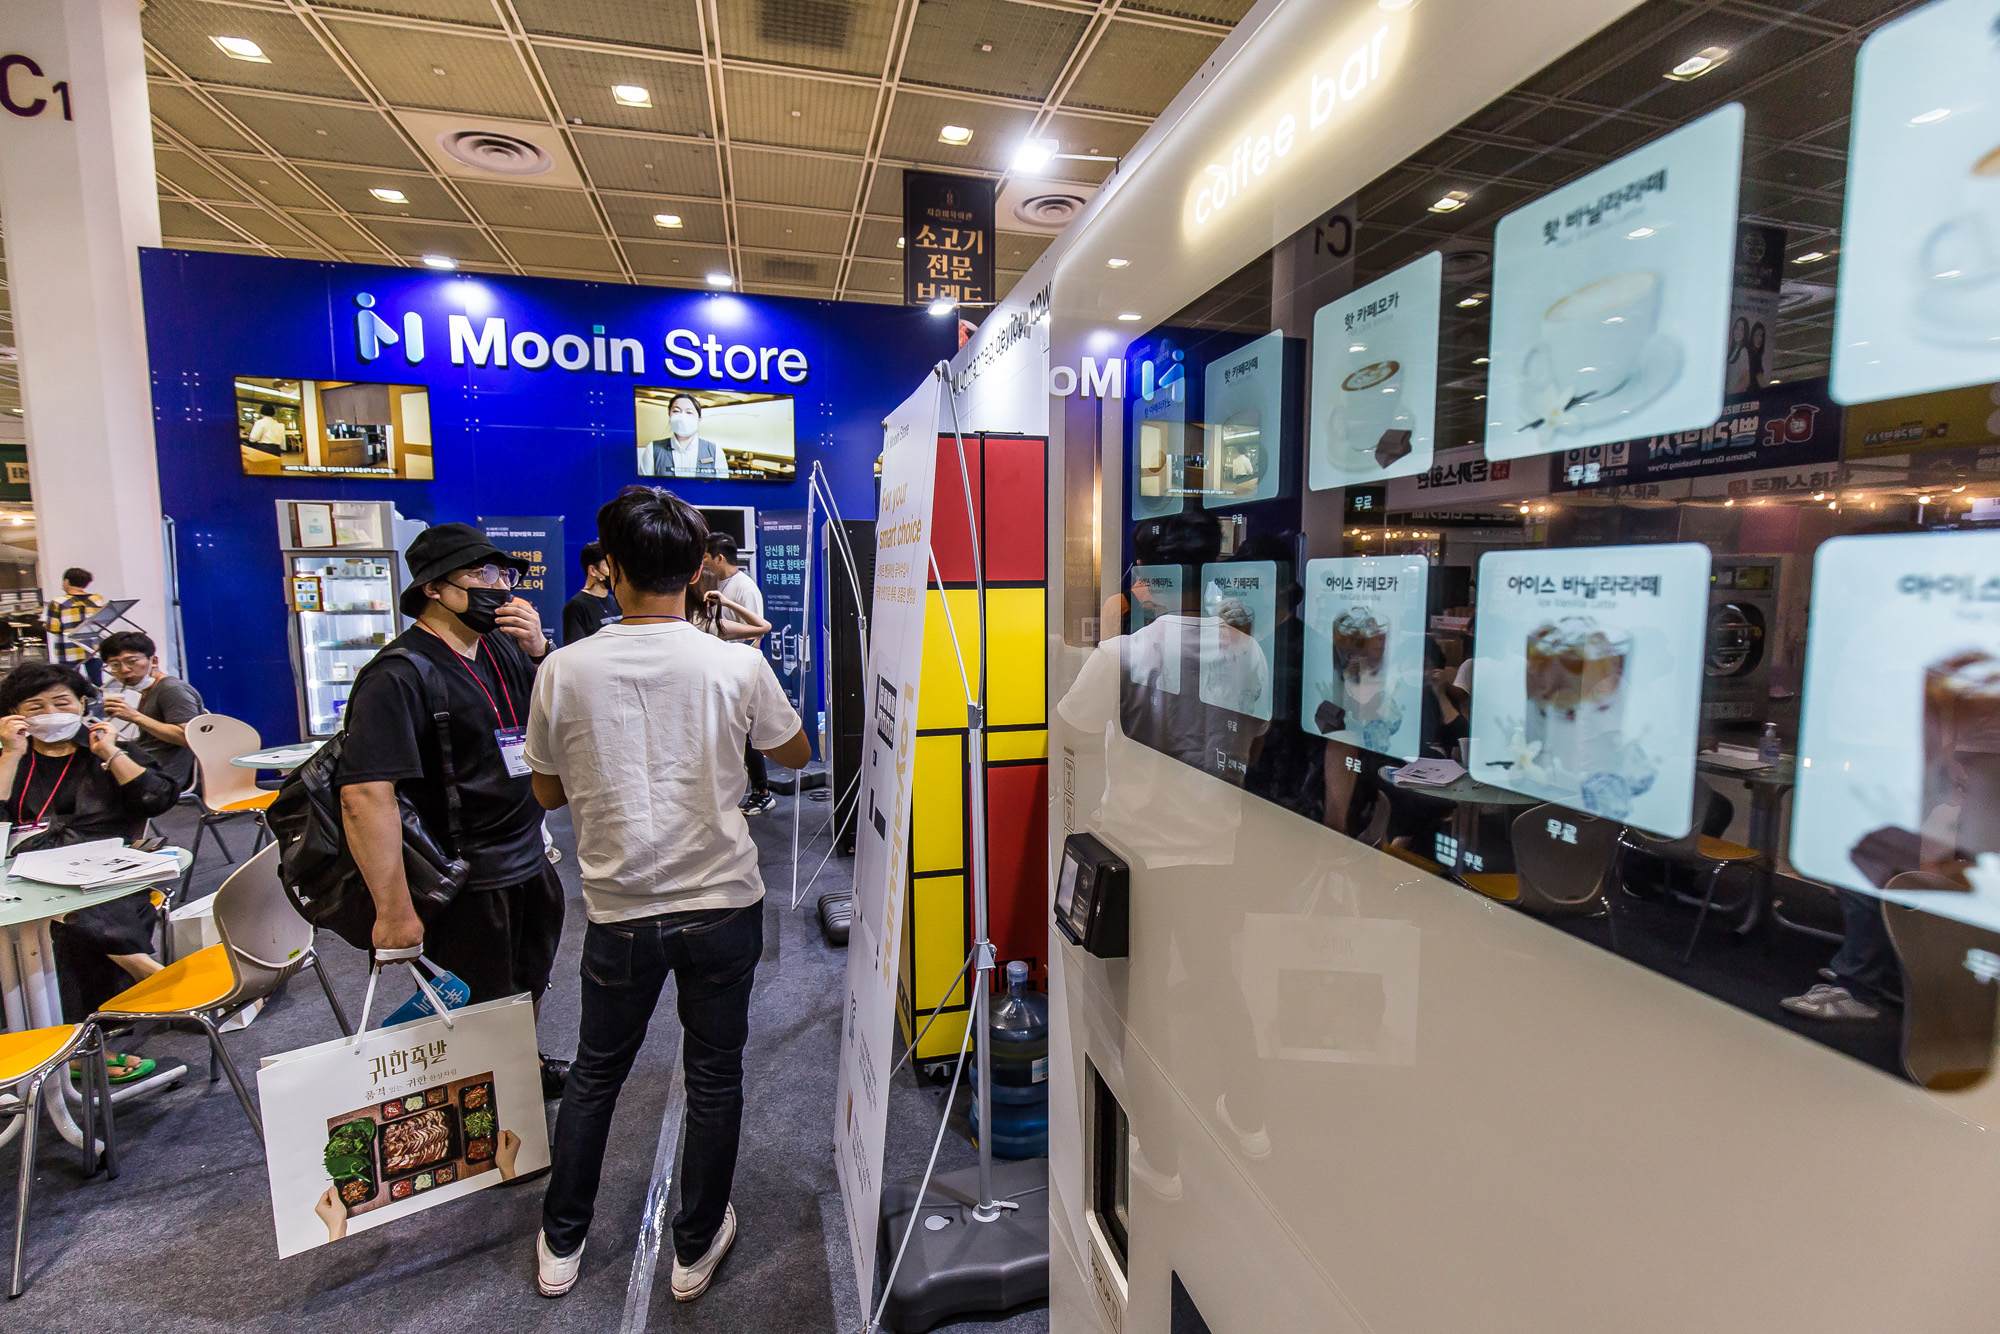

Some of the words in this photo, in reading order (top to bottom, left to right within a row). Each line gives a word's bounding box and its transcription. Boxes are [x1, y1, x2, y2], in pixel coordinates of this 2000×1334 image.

[0, 54, 73, 121] C1
[1196, 113, 1296, 224] coffee
[1311, 25, 1389, 132] bar
[915, 224, 983, 255] 소고기
[926, 254, 973, 281] 전문
[915, 282, 985, 309] 브랜드
[1356, 291, 1400, 322] 카페모카
[448, 314, 645, 374] Mooin
[664, 328, 810, 382] Store
[892, 481, 909, 515] your
[1354, 495, 1373, 511] 무료
[879, 522, 897, 550] smart
[897, 514, 922, 546] choice
[765, 545, 785, 557] 당신을
[786, 544, 800, 556] 위한
[765, 559, 785, 571] 새로운
[766, 573, 779, 585] 무인
[780, 573, 801, 586] 플랫폼
[1214, 577, 1232, 589] 아이스
[1326, 577, 1354, 592] 아이스
[1356, 576, 1399, 592] 카페모카
[1507, 575, 1557, 595] 아이스
[1561, 574, 1663, 599] 바닐라라떼
[1345, 756, 1362, 773] 무료
[368, 1039, 448, 1085] 귀한족발
[365, 1086, 386, 1101] 품격
[406, 1074, 427, 1088] 귀한
